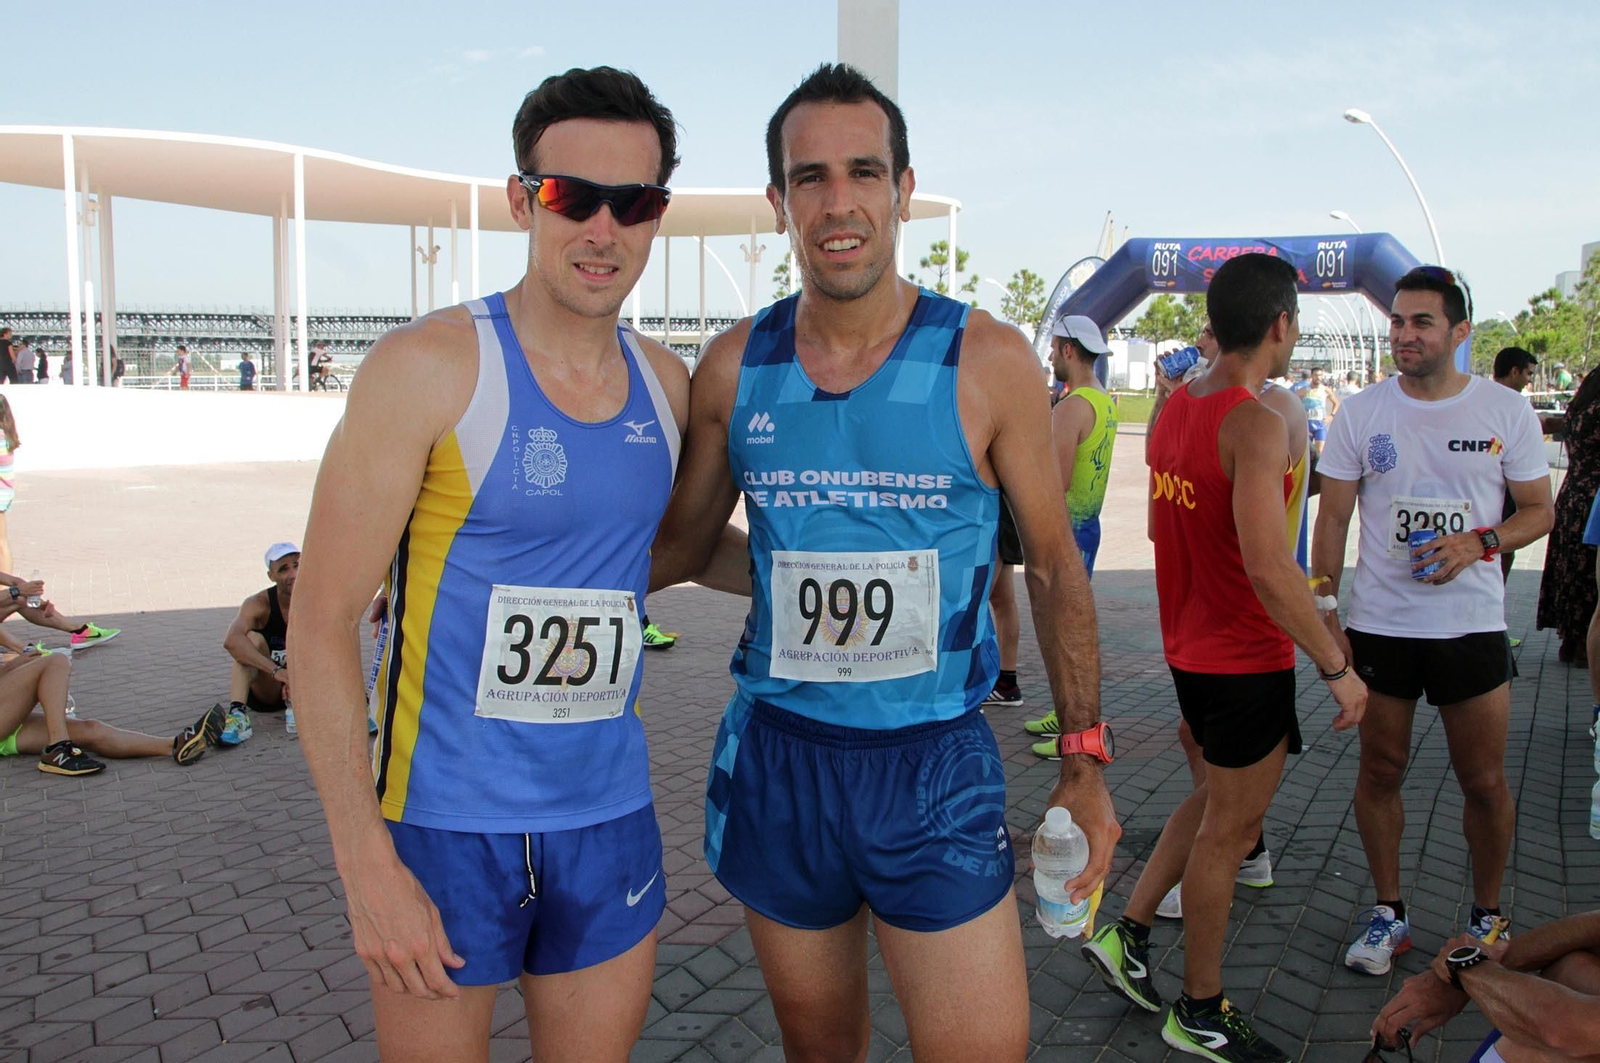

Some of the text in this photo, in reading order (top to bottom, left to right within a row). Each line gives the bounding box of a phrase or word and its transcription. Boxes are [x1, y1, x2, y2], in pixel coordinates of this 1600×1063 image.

[1317, 241, 1347, 250] RUTA
[1152, 250, 1178, 276] 091
[1316, 250, 1345, 277] 091
[746, 435, 774, 444] mobel
[1448, 439, 1491, 452] CNP
[744, 470, 952, 489] CLUB ONUBENSE
[773, 490, 948, 510] ATLETISMO
[1396, 509, 1464, 543] 3289
[811, 561, 848, 570] GENERAL
[497, 595, 542, 606] DIRECCIÓN
[543, 598, 577, 608] GENERAL
[579, 600, 589, 608] DE
[590, 600, 600, 608] LA
[798, 577, 894, 646] 999
[497, 614, 623, 686] 3251
[779, 648, 849, 663] AGRUPACIÓN
[853, 646, 920, 663] DEPORTIVA
[837, 667, 852, 677] 999
[486, 687, 627, 703] AGRUPACIÓN DEPORTIVA
[552, 707, 571, 719] 3251
[943, 846, 983, 876] DE
